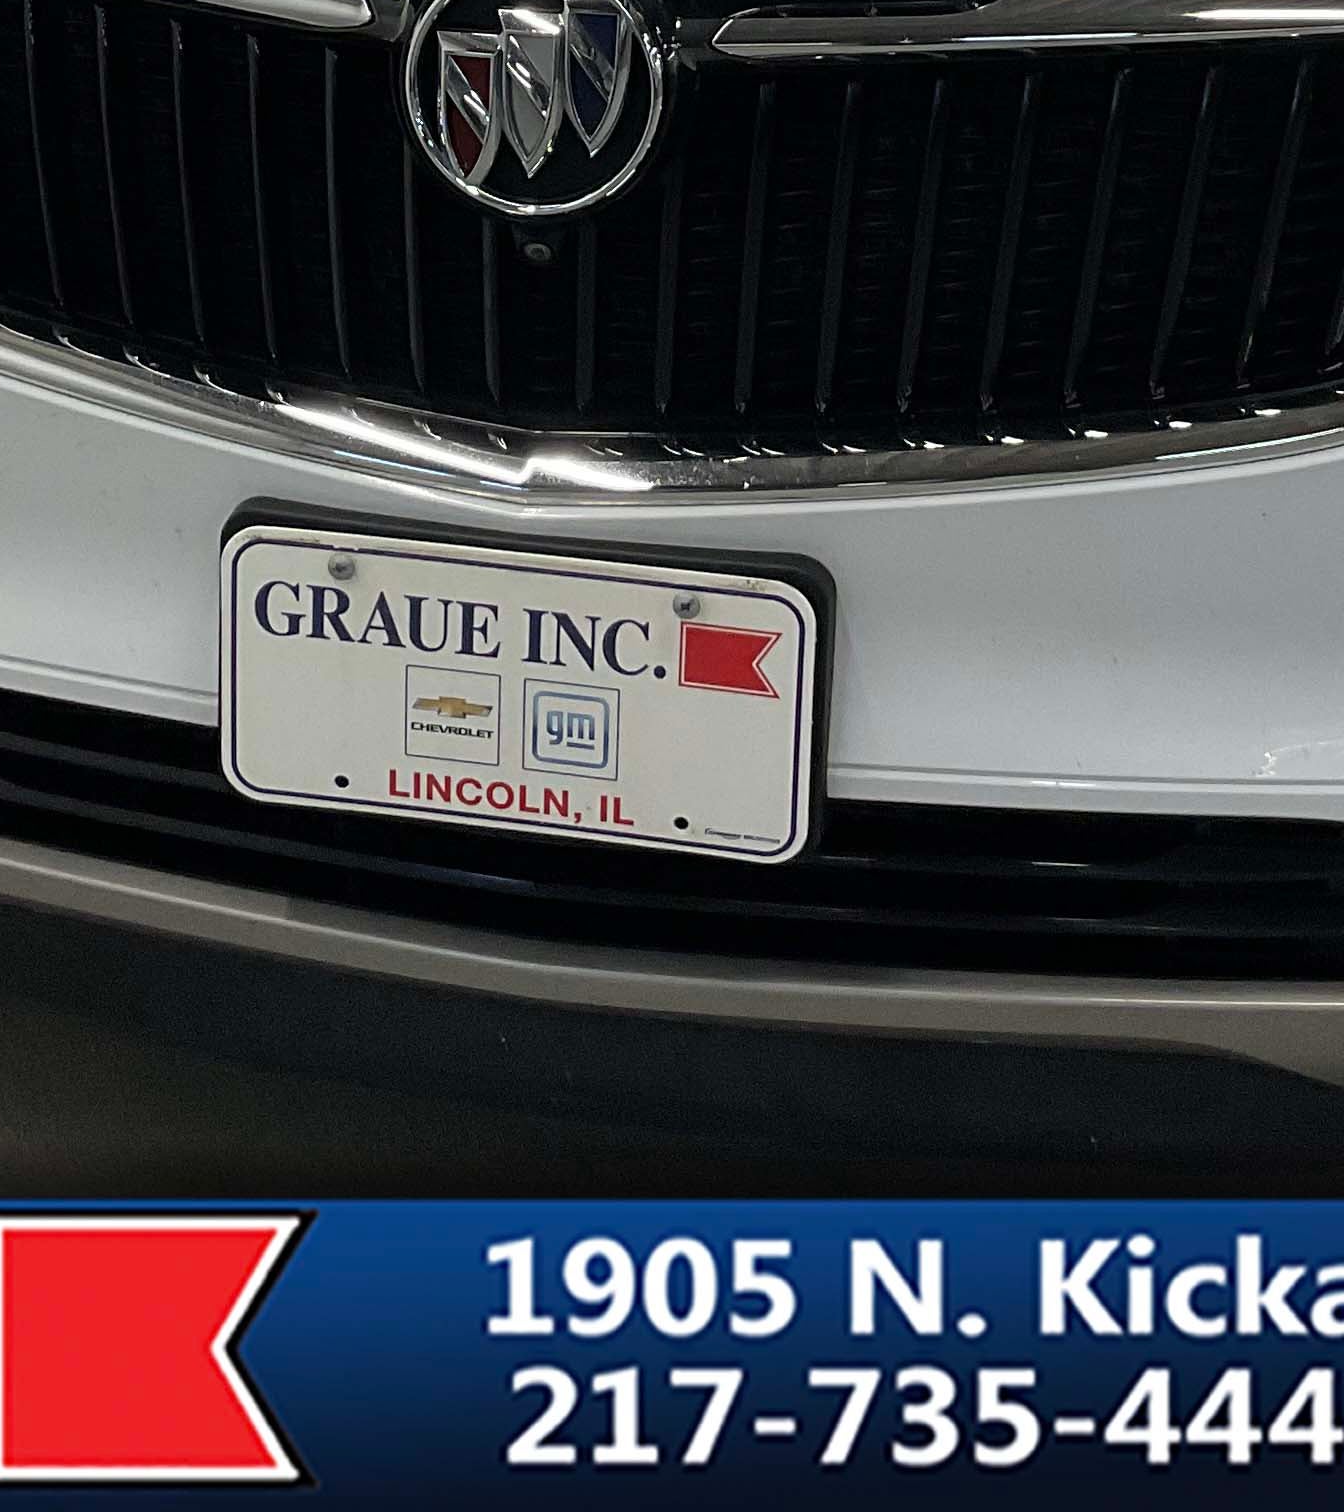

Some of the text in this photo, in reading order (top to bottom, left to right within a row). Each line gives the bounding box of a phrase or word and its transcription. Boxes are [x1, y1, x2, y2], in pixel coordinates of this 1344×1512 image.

[253, 580, 668, 680] GRAUE INC.
[410, 721, 494, 739] CHEVROLET
[546, 707, 596, 750] gm
[388, 768, 635, 827] LINCOLN, IL
